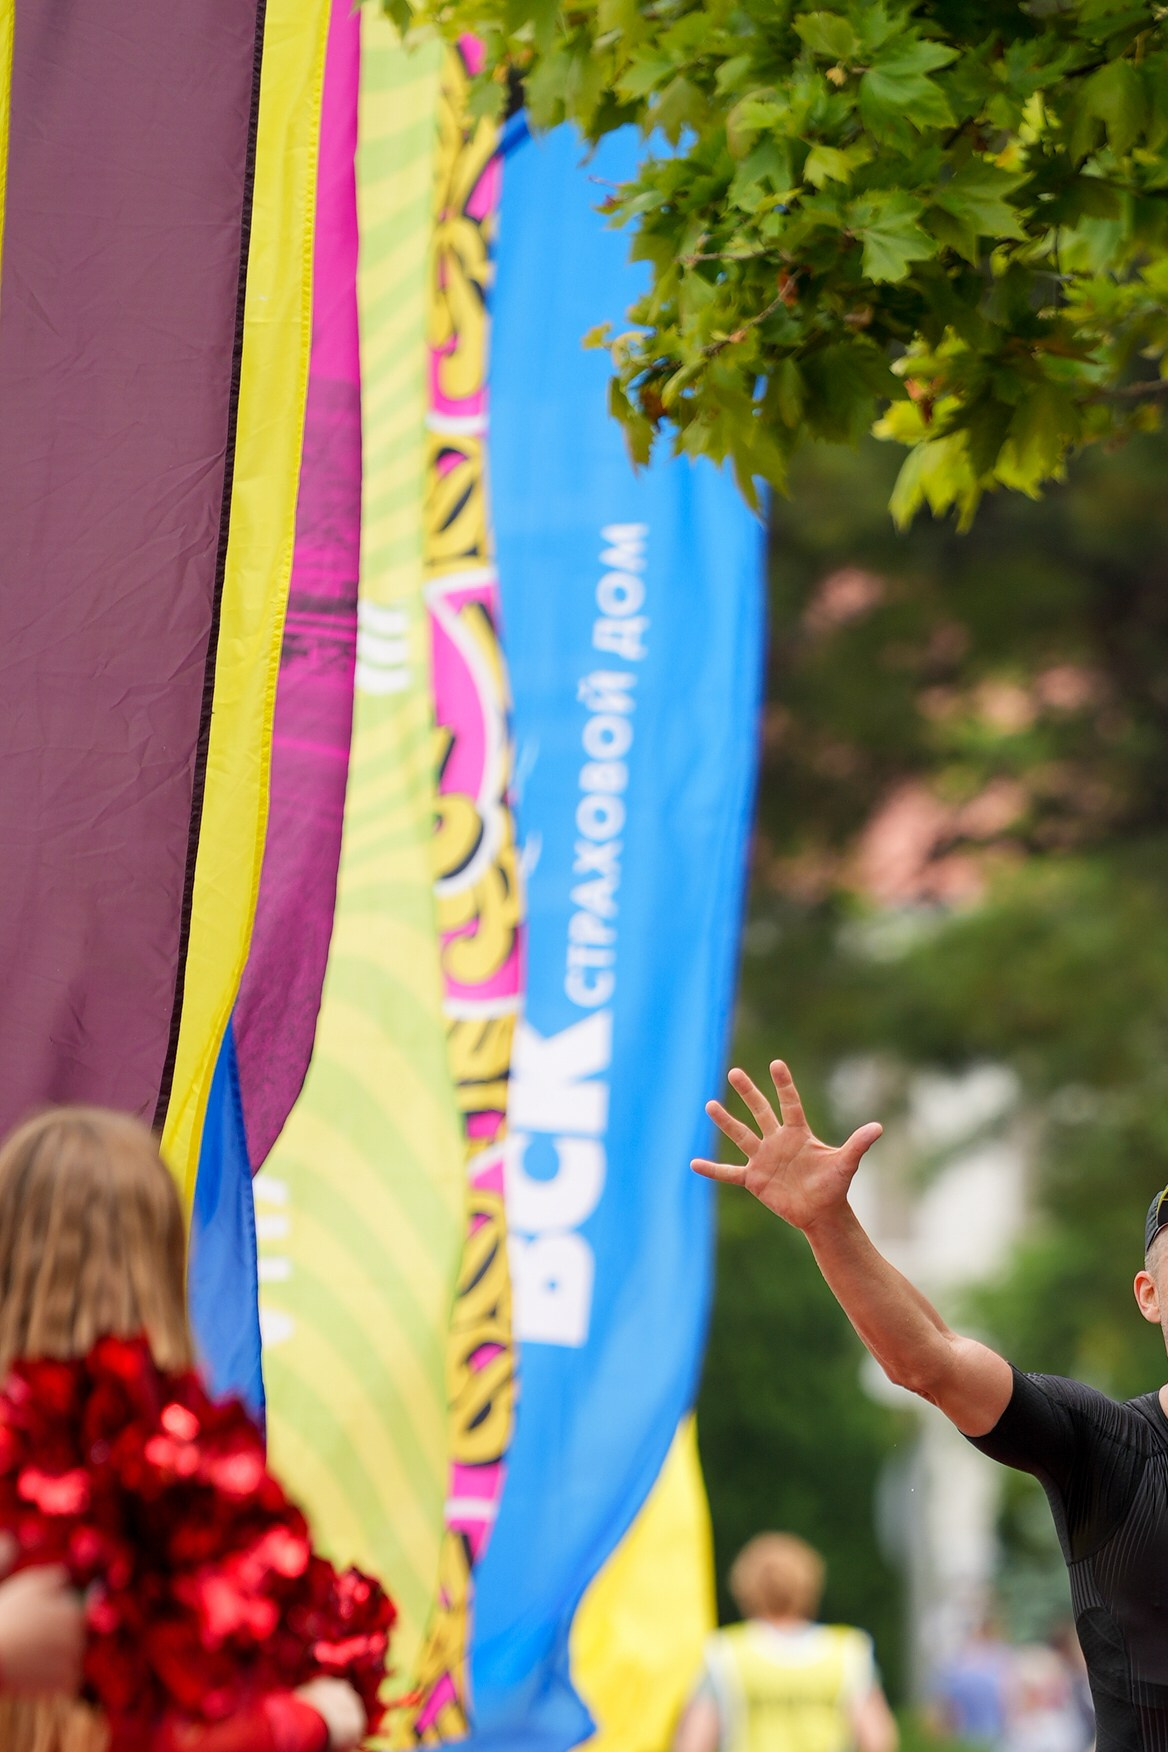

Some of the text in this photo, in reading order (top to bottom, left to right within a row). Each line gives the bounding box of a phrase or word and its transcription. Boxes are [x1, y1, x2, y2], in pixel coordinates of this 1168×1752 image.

[565, 523, 649, 1006] СТРАХОВОЙ ДОМ
[509, 1008, 614, 1348] ВСК
